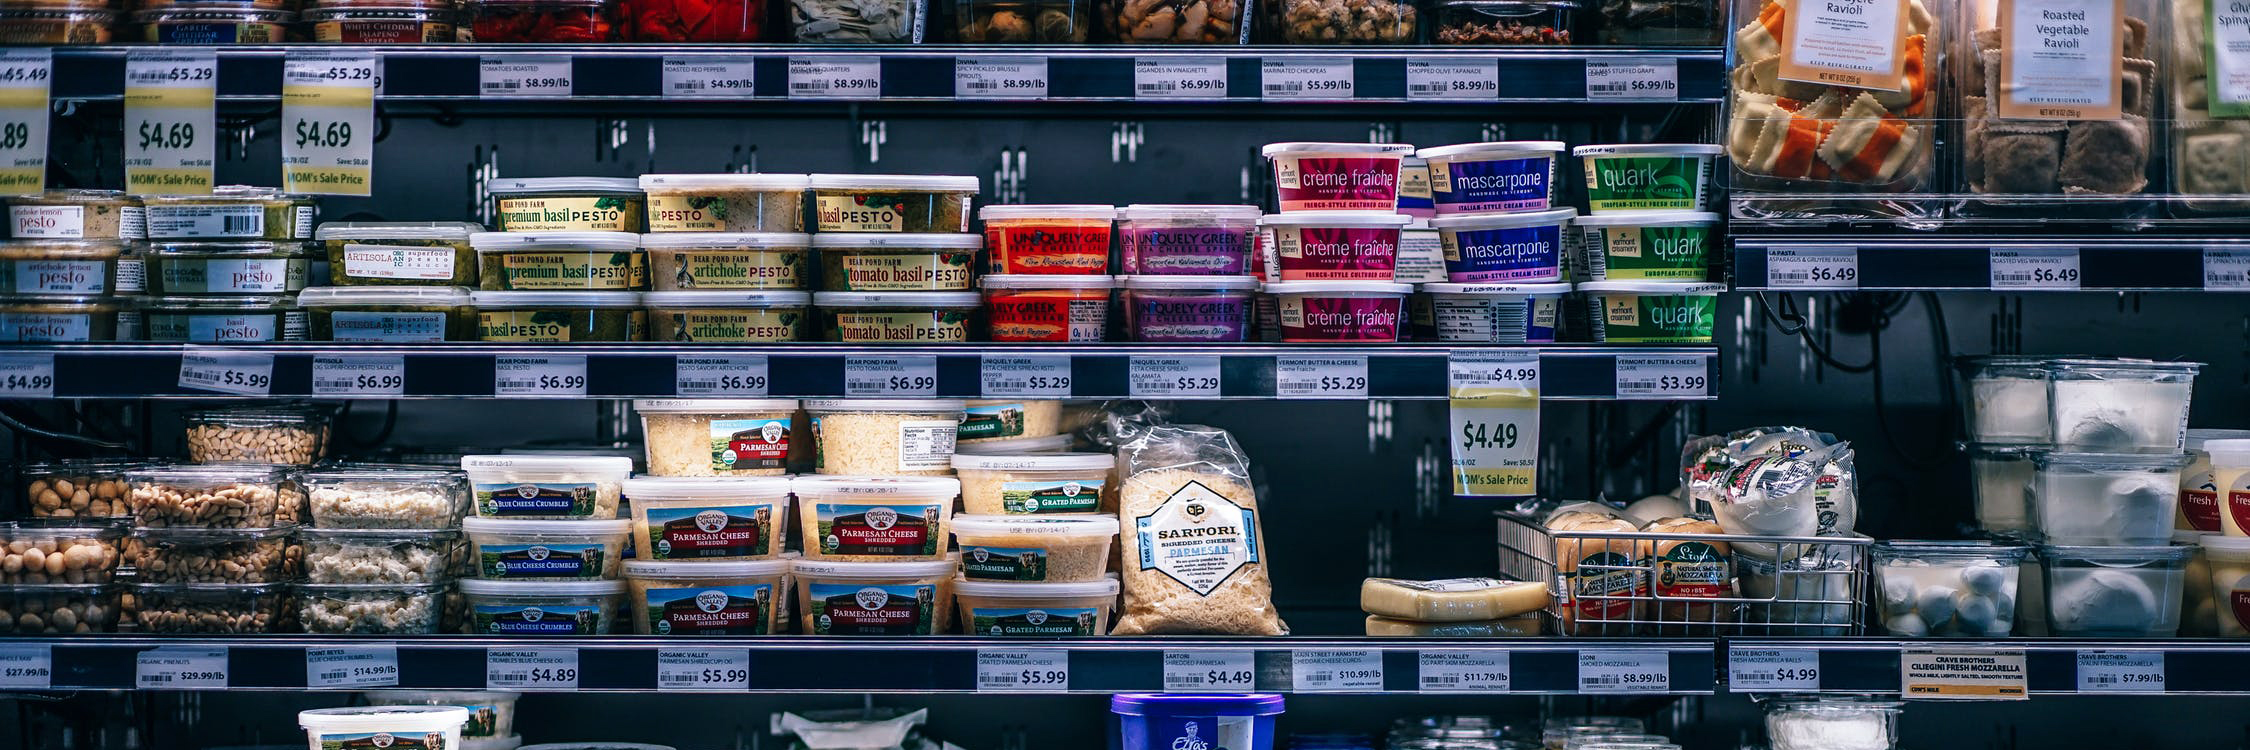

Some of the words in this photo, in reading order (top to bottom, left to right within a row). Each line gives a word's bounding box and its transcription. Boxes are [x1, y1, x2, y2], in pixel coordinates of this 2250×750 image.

[1827, 3, 1863, 14] Ravioli
[2043, 10, 2085, 20] Roasted
[344, 23, 370, 31] WHITE
[374, 23, 415, 31] CHEDDAR
[2037, 25, 2090, 36] Vegetable
[2045, 38, 2080, 48] Ravioli
[172, 69, 213, 82] $5.29
[329, 68, 371, 81] $5.29
[525, 78, 570, 89] $8.99/lb
[711, 79, 753, 90] $4.99/lb
[834, 79, 879, 91] $8.99/lb
[1003, 79, 1046, 90] $8.99/lb
[1180, 80, 1225, 91] $6.99/lb
[1307, 80, 1352, 91] $5.99/lb
[1452, 80, 1497, 92] $8.99/lb
[1631, 80, 1676, 92] $6.99/lb
[139, 120, 194, 150] $4.69
[296, 118, 352, 149] $4.69
[131, 173, 163, 185] MOM's
[165, 174, 182, 185] Sale
[184, 174, 207, 188] Price
[287, 172, 318, 185] MOM's
[319, 173, 339, 184] Sale
[341, 173, 363, 186] Price
[1304, 170, 1347, 187] crème
[1352, 168, 1393, 187] fraîche
[1605, 164, 1659, 188] quark
[1458, 174, 1541, 192] mascarpone
[1459, 203, 1501, 211] ITALIAN-STYLE
[503, 210, 540, 224] premium
[544, 208, 569, 221] basil
[572, 211, 618, 221] PESTO
[662, 211, 702, 221] PESTO
[843, 211, 893, 222] PESTO
[20, 216, 55, 232] pesto
[1201, 233, 1237, 244] GREEK
[1654, 233, 1702, 256] quark
[1305, 238, 1350, 256] crème
[1355, 236, 1394, 256] fraîche
[1466, 240, 1550, 260] mascarpone
[511, 266, 558, 281] premium
[562, 264, 588, 278] basil
[591, 268, 625, 279] PESTO
[694, 264, 747, 278] artichoke
[750, 267, 790, 278] PESTO
[849, 266, 888, 282] tomato
[893, 264, 922, 281] basil
[925, 269, 966, 281] PESTO
[1811, 267, 1856, 281] $6.49
[2034, 268, 2078, 283] $6.49
[39, 270, 84, 288] pesto
[233, 270, 273, 287] pesto
[1307, 308, 1351, 326] crème
[1357, 306, 1396, 326] fraîche
[1651, 304, 1702, 325] quark
[18, 324, 64, 342] pesto
[215, 325, 259, 341] pesto
[511, 324, 560, 337] PESTO
[692, 324, 745, 338] artichoke
[748, 328, 789, 339] PESTO
[843, 325, 881, 341] tomato
[884, 323, 913, 340] basil
[917, 328, 962, 340] PESTO
[224, 371, 269, 387] $5.99
[1495, 368, 1536, 382] $4.99
[7, 376, 52, 390] $4.99
[357, 376, 402, 390] $6.99
[540, 376, 584, 390] $6.99
[721, 376, 766, 390] $6.99
[890, 376, 934, 390] $6.99
[1029, 377, 1070, 390] $5.29
[1178, 377, 1218, 390] $5.29
[1321, 377, 1366, 391] $5.29
[1660, 376, 1704, 391] $3.99
[1463, 420, 1518, 450] $4.49
[1457, 475, 1485, 486] MOM's
[1487, 475, 1505, 486] Sale
[1507, 475, 1528, 486] Price
[498, 500, 511, 508] BLUE
[512, 500, 534, 508] CHEESE
[536, 500, 569, 508] CRUMBLES
[2189, 494, 2211, 505] Fresh
[697, 513, 728, 522] ORGANIC
[866, 510, 897, 522] ORGANIC
[673, 532, 718, 541] PARMESAN
[720, 531, 750, 540] CHEESE
[842, 529, 887, 538] PARMESAN
[889, 530, 918, 538] CHEESE
[1170, 546, 1229, 557] PARMESAN
[506, 562, 521, 570] BLUE
[522, 562, 545, 570] CHEESE
[546, 561, 579, 569] CRUMBLES
[673, 613, 719, 621] PARMESAN
[720, 611, 750, 620] CHEESE
[834, 609, 878, 618] PARMESAN
[879, 609, 910, 618] CHEESE
[6, 668, 49, 678] $27.99/lb
[181, 671, 225, 681] $29.99/lb
[354, 666, 397, 676] $14.99/lb
[532, 668, 576, 683] $4.89
[702, 669, 747, 684] $5.99
[1021, 670, 1066, 685] $5.99
[1208, 670, 1252, 685] $4.49
[1339, 669, 1381, 679] $10.99/lb
[1464, 672, 1508, 682] $11.79/lb
[1776, 668, 1817, 681] $4.99
[1623, 673, 1667, 683] $8.99/lb
[2122, 674, 2164, 684] $7.99/lb
